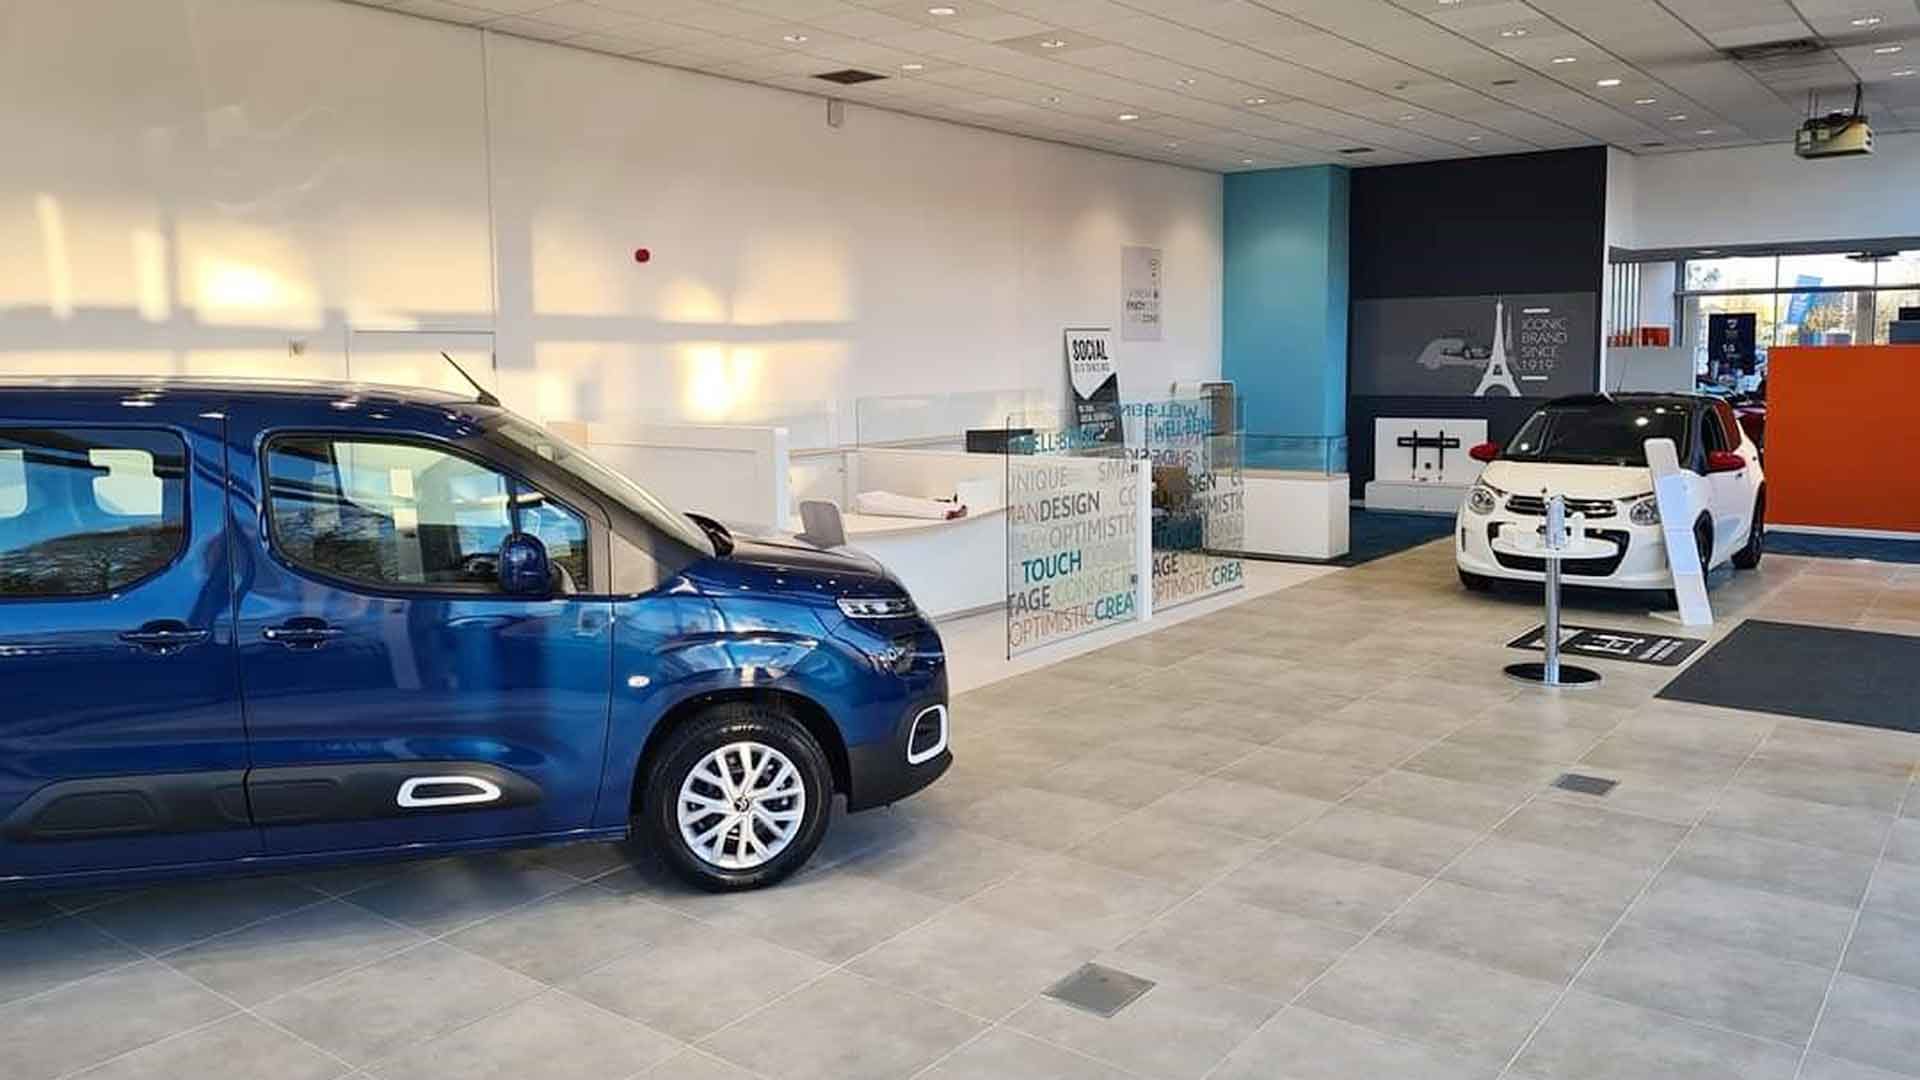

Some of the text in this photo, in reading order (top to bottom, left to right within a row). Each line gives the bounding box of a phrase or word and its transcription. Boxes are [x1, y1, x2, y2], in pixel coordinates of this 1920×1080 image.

[1071, 337, 1109, 361] SOCIAL
[1521, 331, 1568, 345] BRAND
[1521, 345, 1559, 358] SINCE
[1521, 359, 1553, 371] 1919
[1039, 490, 1101, 522] DESIGN
[1021, 549, 1082, 584] TOUCH
[1010, 601, 1094, 648] OPTIMISTIC
